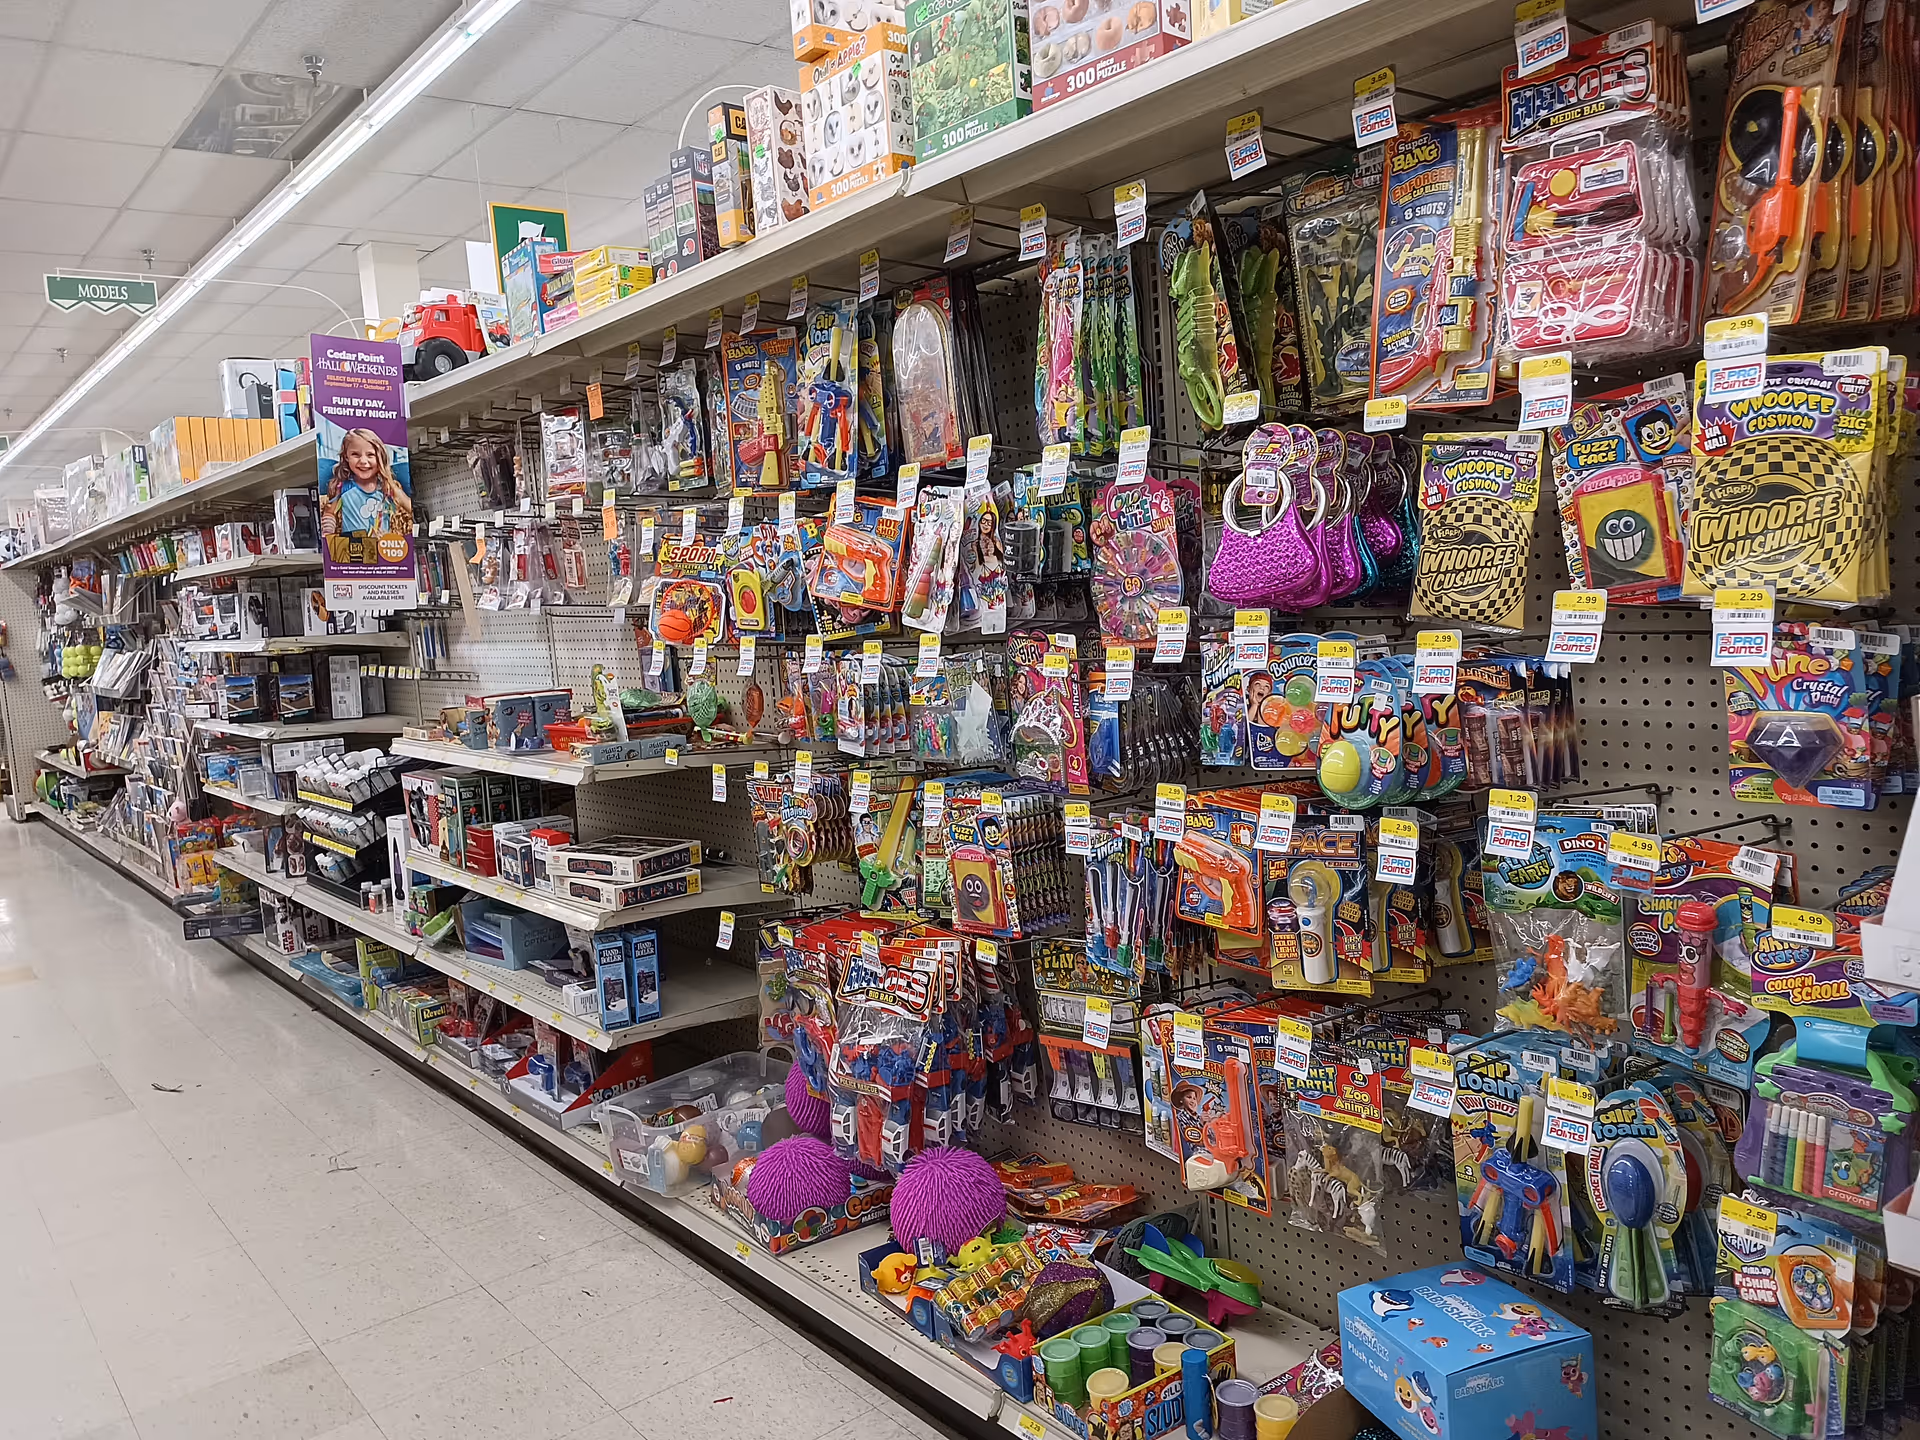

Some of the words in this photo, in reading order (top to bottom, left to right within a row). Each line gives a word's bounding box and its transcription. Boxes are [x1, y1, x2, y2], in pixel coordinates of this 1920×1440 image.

[813, 60, 829, 84] Owl
[837, 36, 866, 68] Apple?
[1096, 58, 1115, 70] piece
[888, 69, 910, 80] Apple?
[1096, 62, 1127, 81] PUZZLE
[1066, 69, 1095, 93] 300
[1509, 50, 1646, 138] HEROES
[1550, 108, 1581, 126] MEDIC
[1584, 102, 1605, 114] BAG
[965, 122, 989, 139] PUZZLE
[941, 130, 965, 150] 300
[1398, 132, 1431, 153] Super
[1390, 144, 1439, 174] BANG
[830, 180, 850, 198] 300
[1392, 166, 1455, 201] ENFORCER
[1404, 208, 1413, 220] 8
[1415, 202, 1447, 216] SHOTS!
[78, 283, 128, 300] MODELS
[1730, 320, 1754, 330] 2.99
[326, 349, 357, 360] Cedar
[358, 352, 385, 363] Point
[1543, 359, 1562, 368] 2.99
[316, 357, 398, 376] HALLOWEEKENDS
[1728, 366, 1759, 378] PRO
[324, 380, 352, 388] September
[332, 396, 350, 406] FUN
[352, 398, 364, 407] BY
[365, 398, 386, 410] DAY,
[1382, 402, 1400, 410] 1.59
[1730, 391, 1836, 418] WHOOPEE
[322, 406, 355, 416] FRIGHT
[355, 408, 368, 417] BY
[369, 410, 398, 419] NIGHT
[1704, 424, 1722, 437] HA
[1748, 414, 1815, 432] CUSHION
[1838, 416, 1868, 430] BIG
[1573, 439, 1618, 454] FUZZY
[1704, 436, 1728, 450] HA!!
[1578, 450, 1618, 466] FACE
[1444, 459, 1514, 480] WHOOPEE
[1456, 478, 1500, 492] CUSHION
[1514, 482, 1532, 492] BIG
[1584, 479, 1612, 493] FUZZY
[1614, 471, 1642, 486] FACE
[1428, 486, 1438, 495] HA
[878, 518, 899, 528] HOT
[1152, 516, 1174, 532] SHINY
[1700, 491, 1842, 546] WHOOPEE
[876, 526, 898, 538] SHOT
[380, 540, 405, 548] ONLY
[1720, 520, 1820, 566] CUSHION
[382, 549, 404, 558] $109
[1422, 548, 1516, 574] WHOOPEE
[1432, 566, 1500, 590] CUSHION
[334, 585, 350, 594] drug
[1740, 592, 1763, 602] 2.29
[1576, 596, 1597, 604] 2.99
[1248, 614, 1264, 622] 2.29
[1245, 644, 1264, 653] PRO
[1733, 636, 1764, 646] PRO
[1333, 646, 1349, 655] 1.99
[1429, 668, 1450, 676] PRO
[1530, 690, 1550, 700] CAPS
[1792, 678, 1849, 697] Crystal
[1810, 691, 1840, 707] Putty
[1166, 788, 1182, 796] 2.99
[1510, 794, 1527, 803] 1.29
[1186, 815, 1214, 828] BANG
[1396, 824, 1412, 832] 2.99
[952, 824, 975, 835] FUZZY
[955, 832, 974, 842] FACE
[1270, 828, 1288, 836] PRO
[1504, 830, 1528, 841] PRO
[1631, 840, 1653, 851] 4.99
[1269, 860, 1286, 869] LITE
[1390, 858, 1410, 867] PRO
[1270, 868, 1288, 879] SPIN
[1508, 860, 1551, 884] EARTH
[1585, 882, 1618, 902] WILDLIFE
[1798, 915, 1822, 926] 4.99
[1044, 953, 1074, 968] PLAY
[1760, 948, 1810, 966] Crafts
[868, 990, 880, 1000] BIG
[880, 992, 894, 1003] BAG
[1792, 983, 1849, 1002] SCROLL
[1296, 1024, 1310, 1033] 2.99
[1286, 1052, 1306, 1062] PRO
[1468, 1053, 1510, 1080] air
[1354, 1073, 1364, 1082] 10
[1457, 1064, 1523, 1100] foam
[1286, 1078, 1336, 1094] EARTH
[1342, 1086, 1370, 1103] Zoo
[1574, 1090, 1593, 1100] 1.99
[1335, 1096, 1380, 1120] Animals
[1458, 1095, 1484, 1112] BOW
[1487, 1098, 1518, 1116] SHOT
[1600, 1108, 1636, 1124] air
[1561, 1122, 1586, 1133] PRO
[1593, 1121, 1656, 1142] foam
[1838, 1120, 1880, 1135] crayons
[1589, 1146, 1605, 1172] BALL
[1464, 1166, 1473, 1176] 3
[1589, 1169, 1607, 1211] ROCKET
[1828, 1186, 1871, 1207] crayons
[1746, 1208, 1767, 1221] 2.59
[1605, 1235, 1614, 1253] SAFE
[1602, 1255, 1610, 1270] AND
[1598, 1270, 1609, 1288] SOFT
[1734, 1272, 1778, 1290] FISHING
[1740, 1288, 1775, 1303] GAME
[1414, 1286, 1452, 1312] BABY
[1442, 1302, 1496, 1338] SHARK
[1344, 1317, 1369, 1344] BABY
[1364, 1334, 1389, 1361] SHARK
[1348, 1341, 1368, 1366] Plush
[1368, 1358, 1388, 1382] Cube
[1455, 1384, 1476, 1399] BABY
[1476, 1376, 1505, 1392] SHARK
